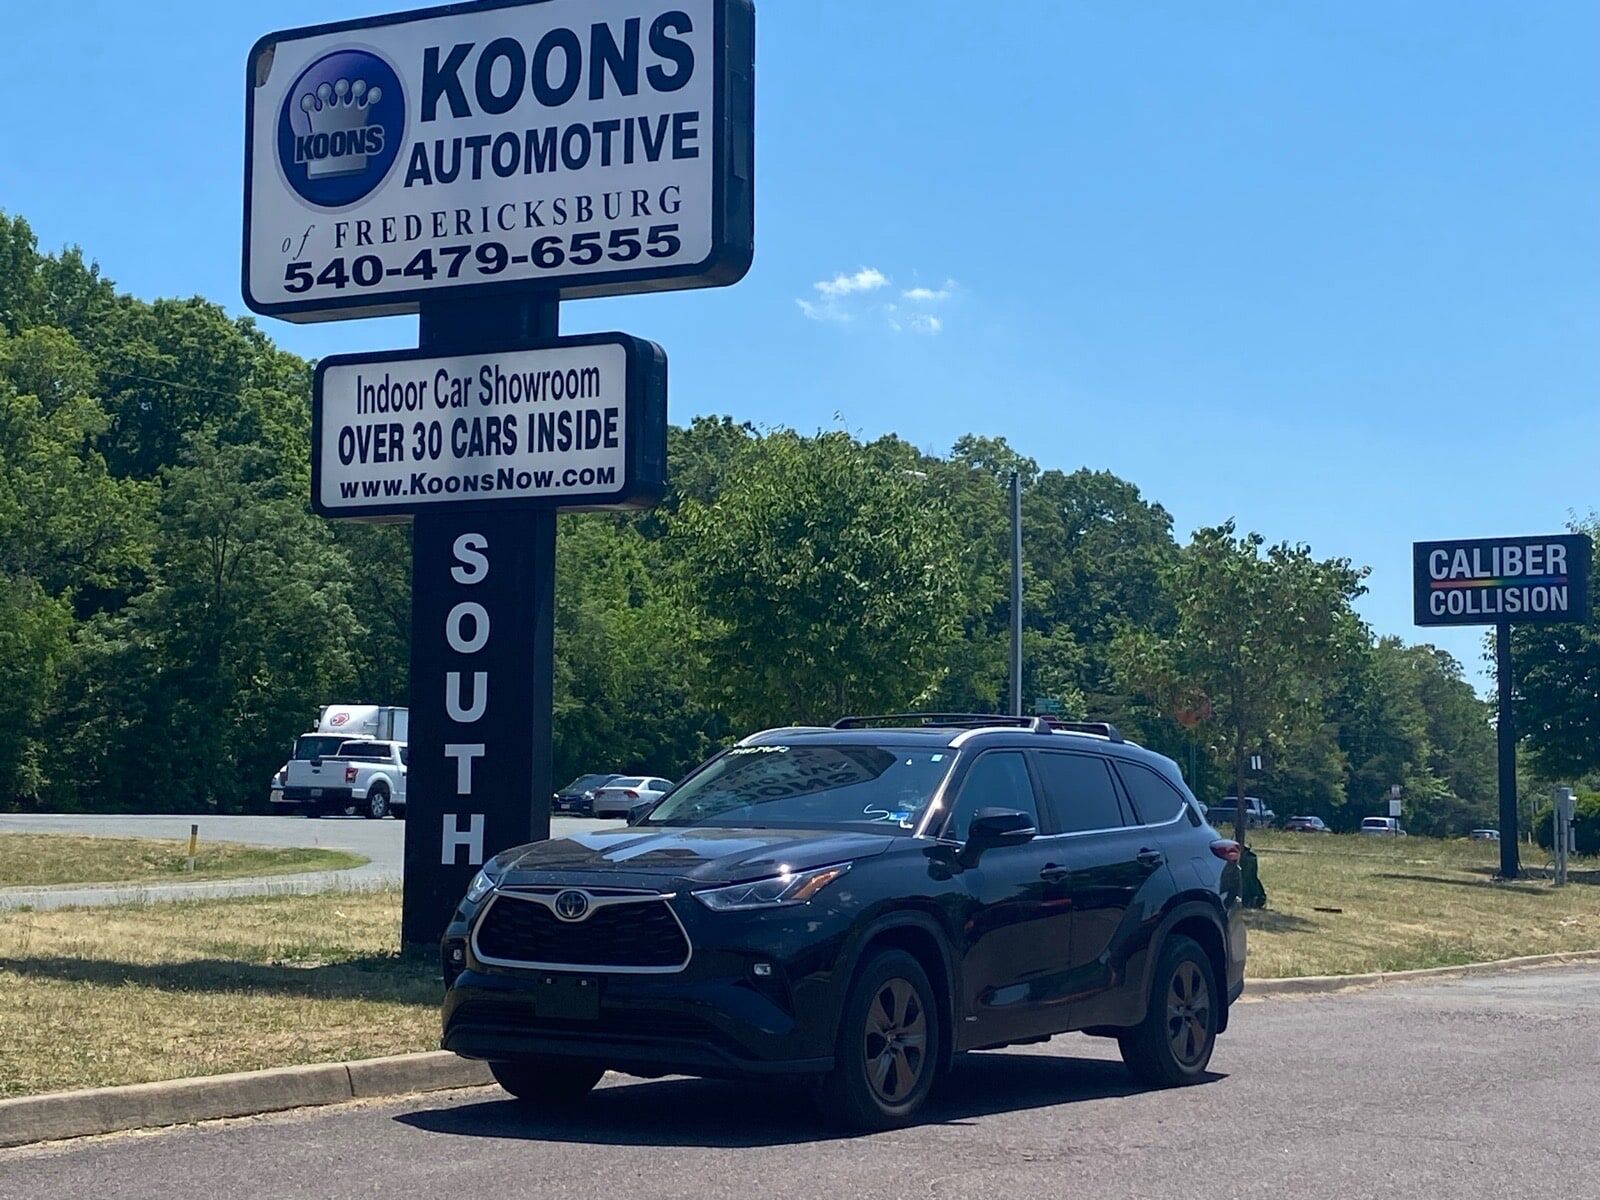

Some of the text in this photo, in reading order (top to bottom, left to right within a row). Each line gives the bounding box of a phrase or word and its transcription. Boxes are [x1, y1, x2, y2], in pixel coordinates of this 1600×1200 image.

[421, 11, 695, 122] KOONS
[296, 127, 384, 162] KOONS
[404, 112, 699, 187] AUTOMOTIVE
[281, 185, 682, 261] of FREDERICKSBURG
[283, 223, 681, 293] 540-479-6555
[356, 364, 600, 415] Indoor Car Showroom
[338, 407, 619, 466] OVER 30 CARS INSIDE
[1429, 544, 1568, 580] CALIBER
[1430, 586, 1568, 616] COLLISION
[441, 532, 490, 865] SOUTH
